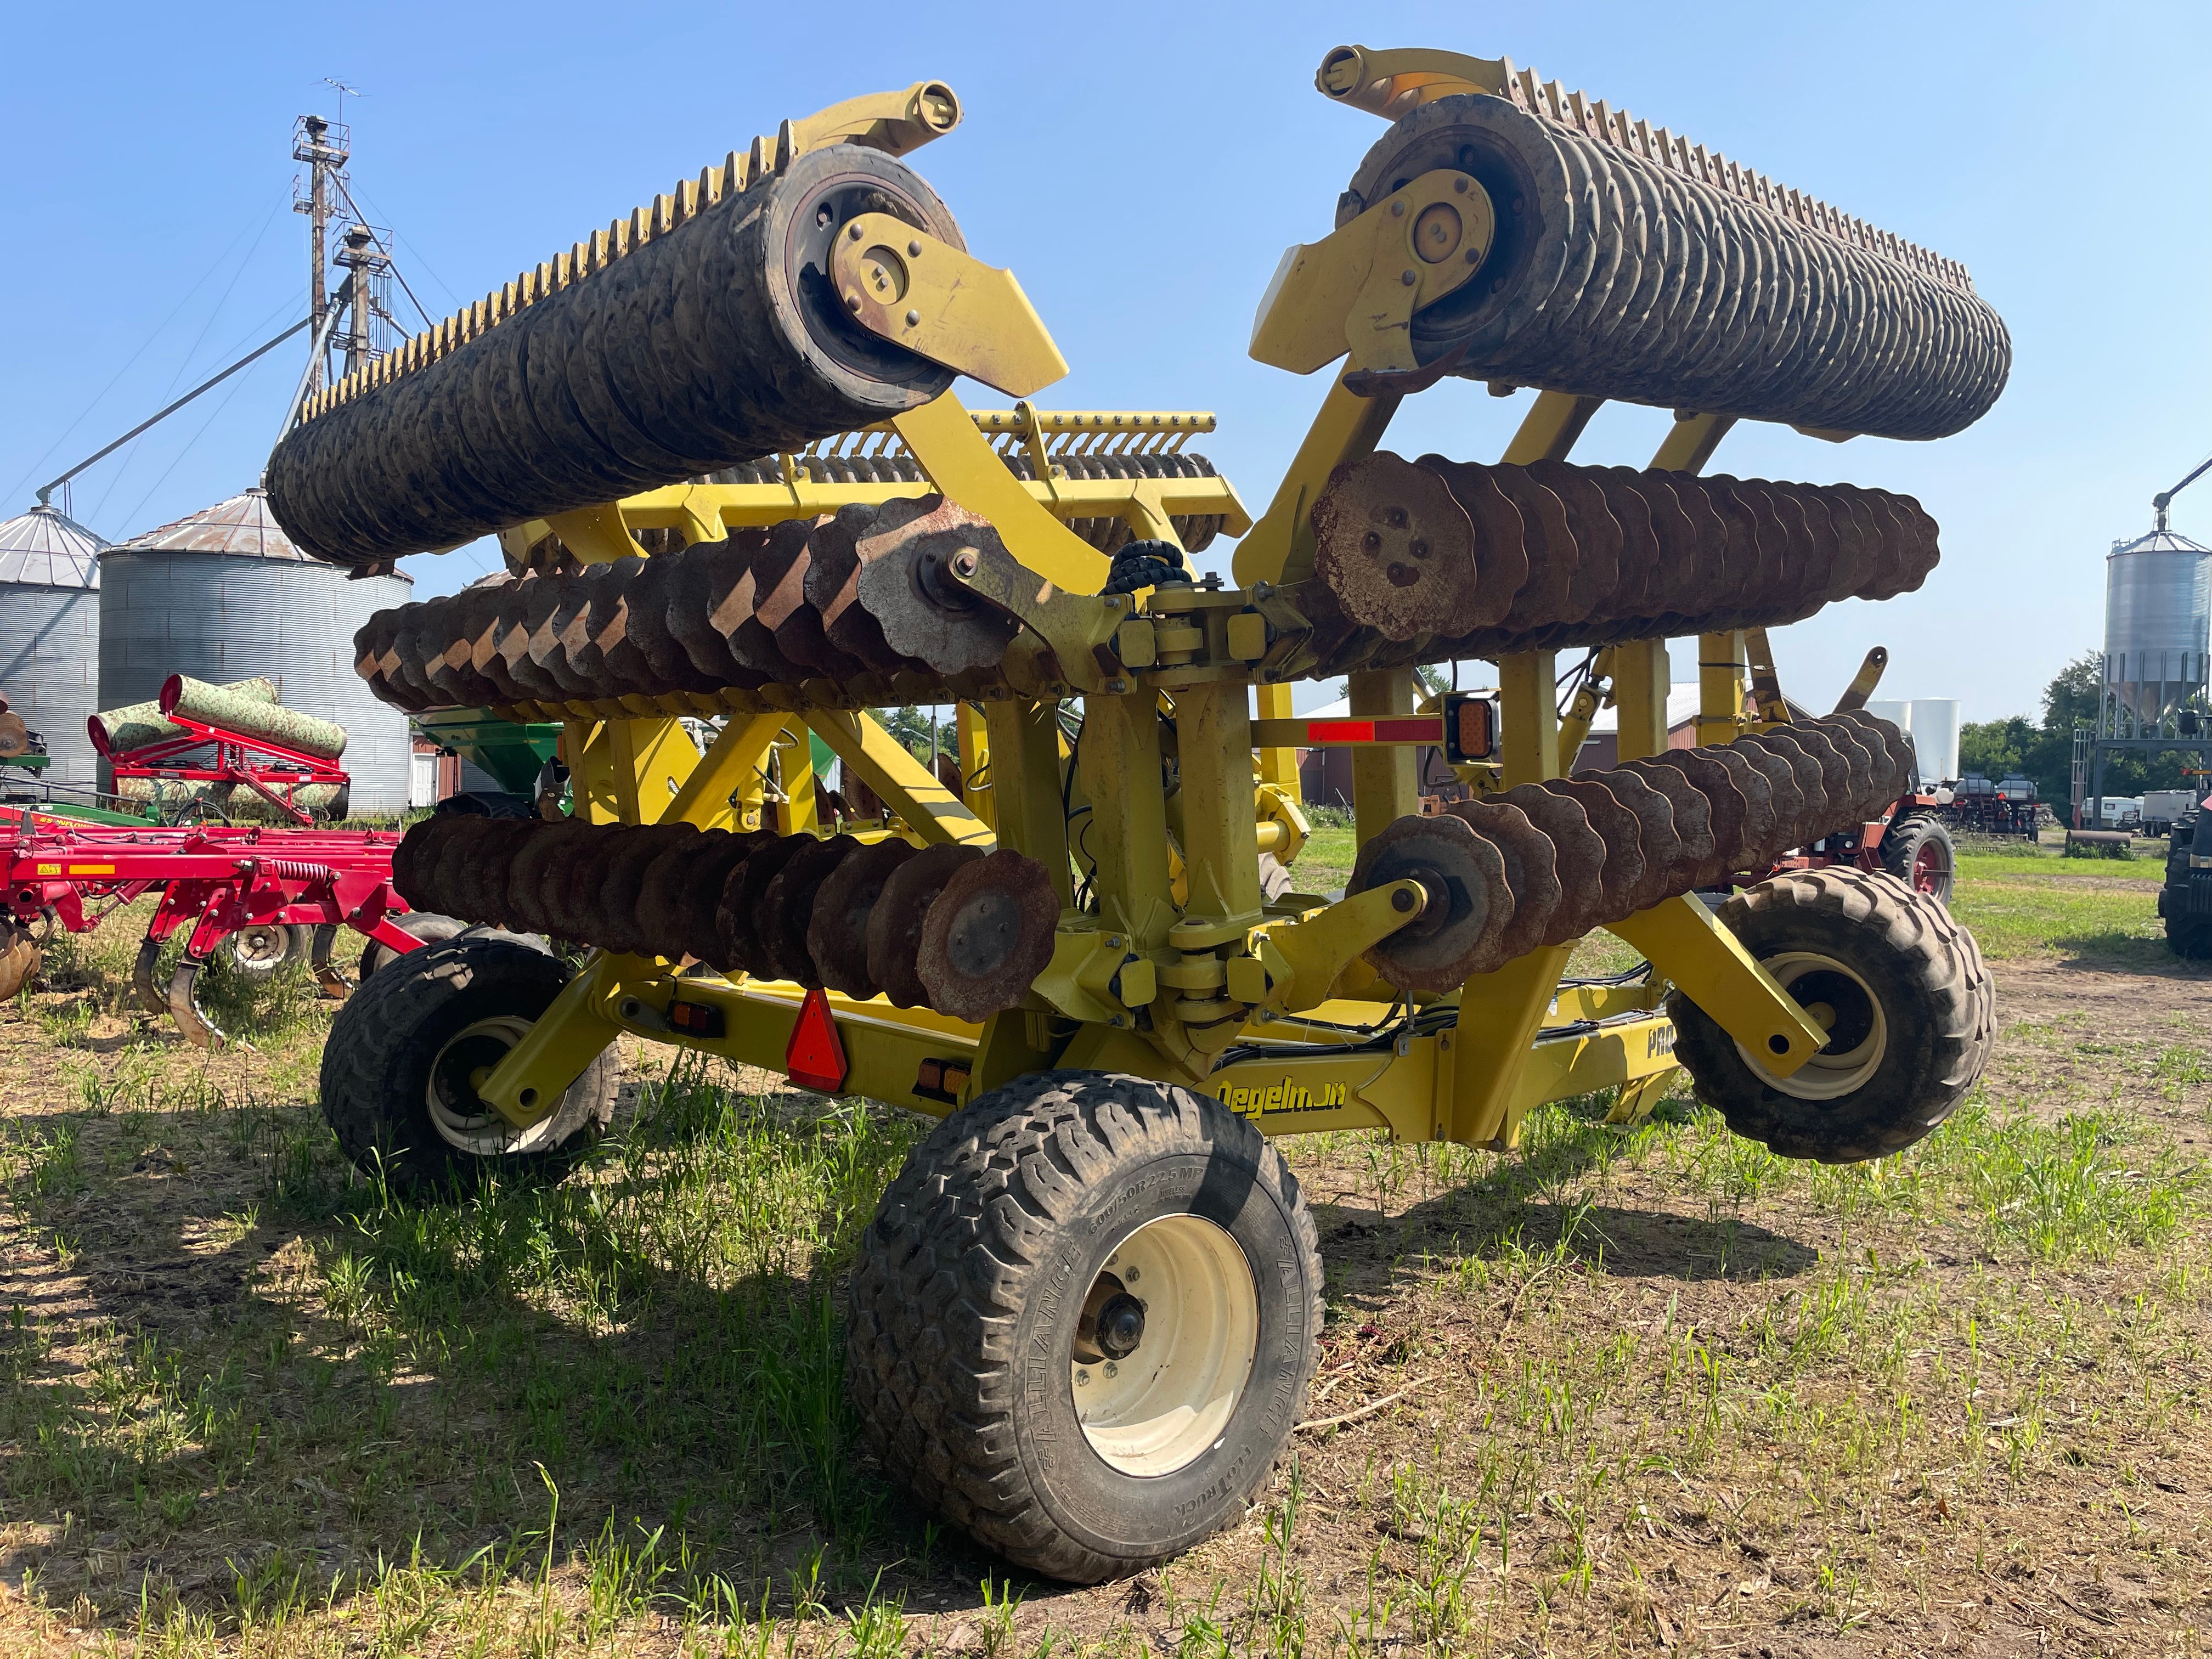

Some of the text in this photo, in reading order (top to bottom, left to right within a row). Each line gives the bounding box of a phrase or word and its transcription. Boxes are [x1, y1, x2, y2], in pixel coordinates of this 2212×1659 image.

[1088, 1169, 1176, 1236] 600/50R22.5
[1028, 1239, 1082, 1444] ALLIANCE
[1259, 1259, 1302, 1440] ALLIANCE
